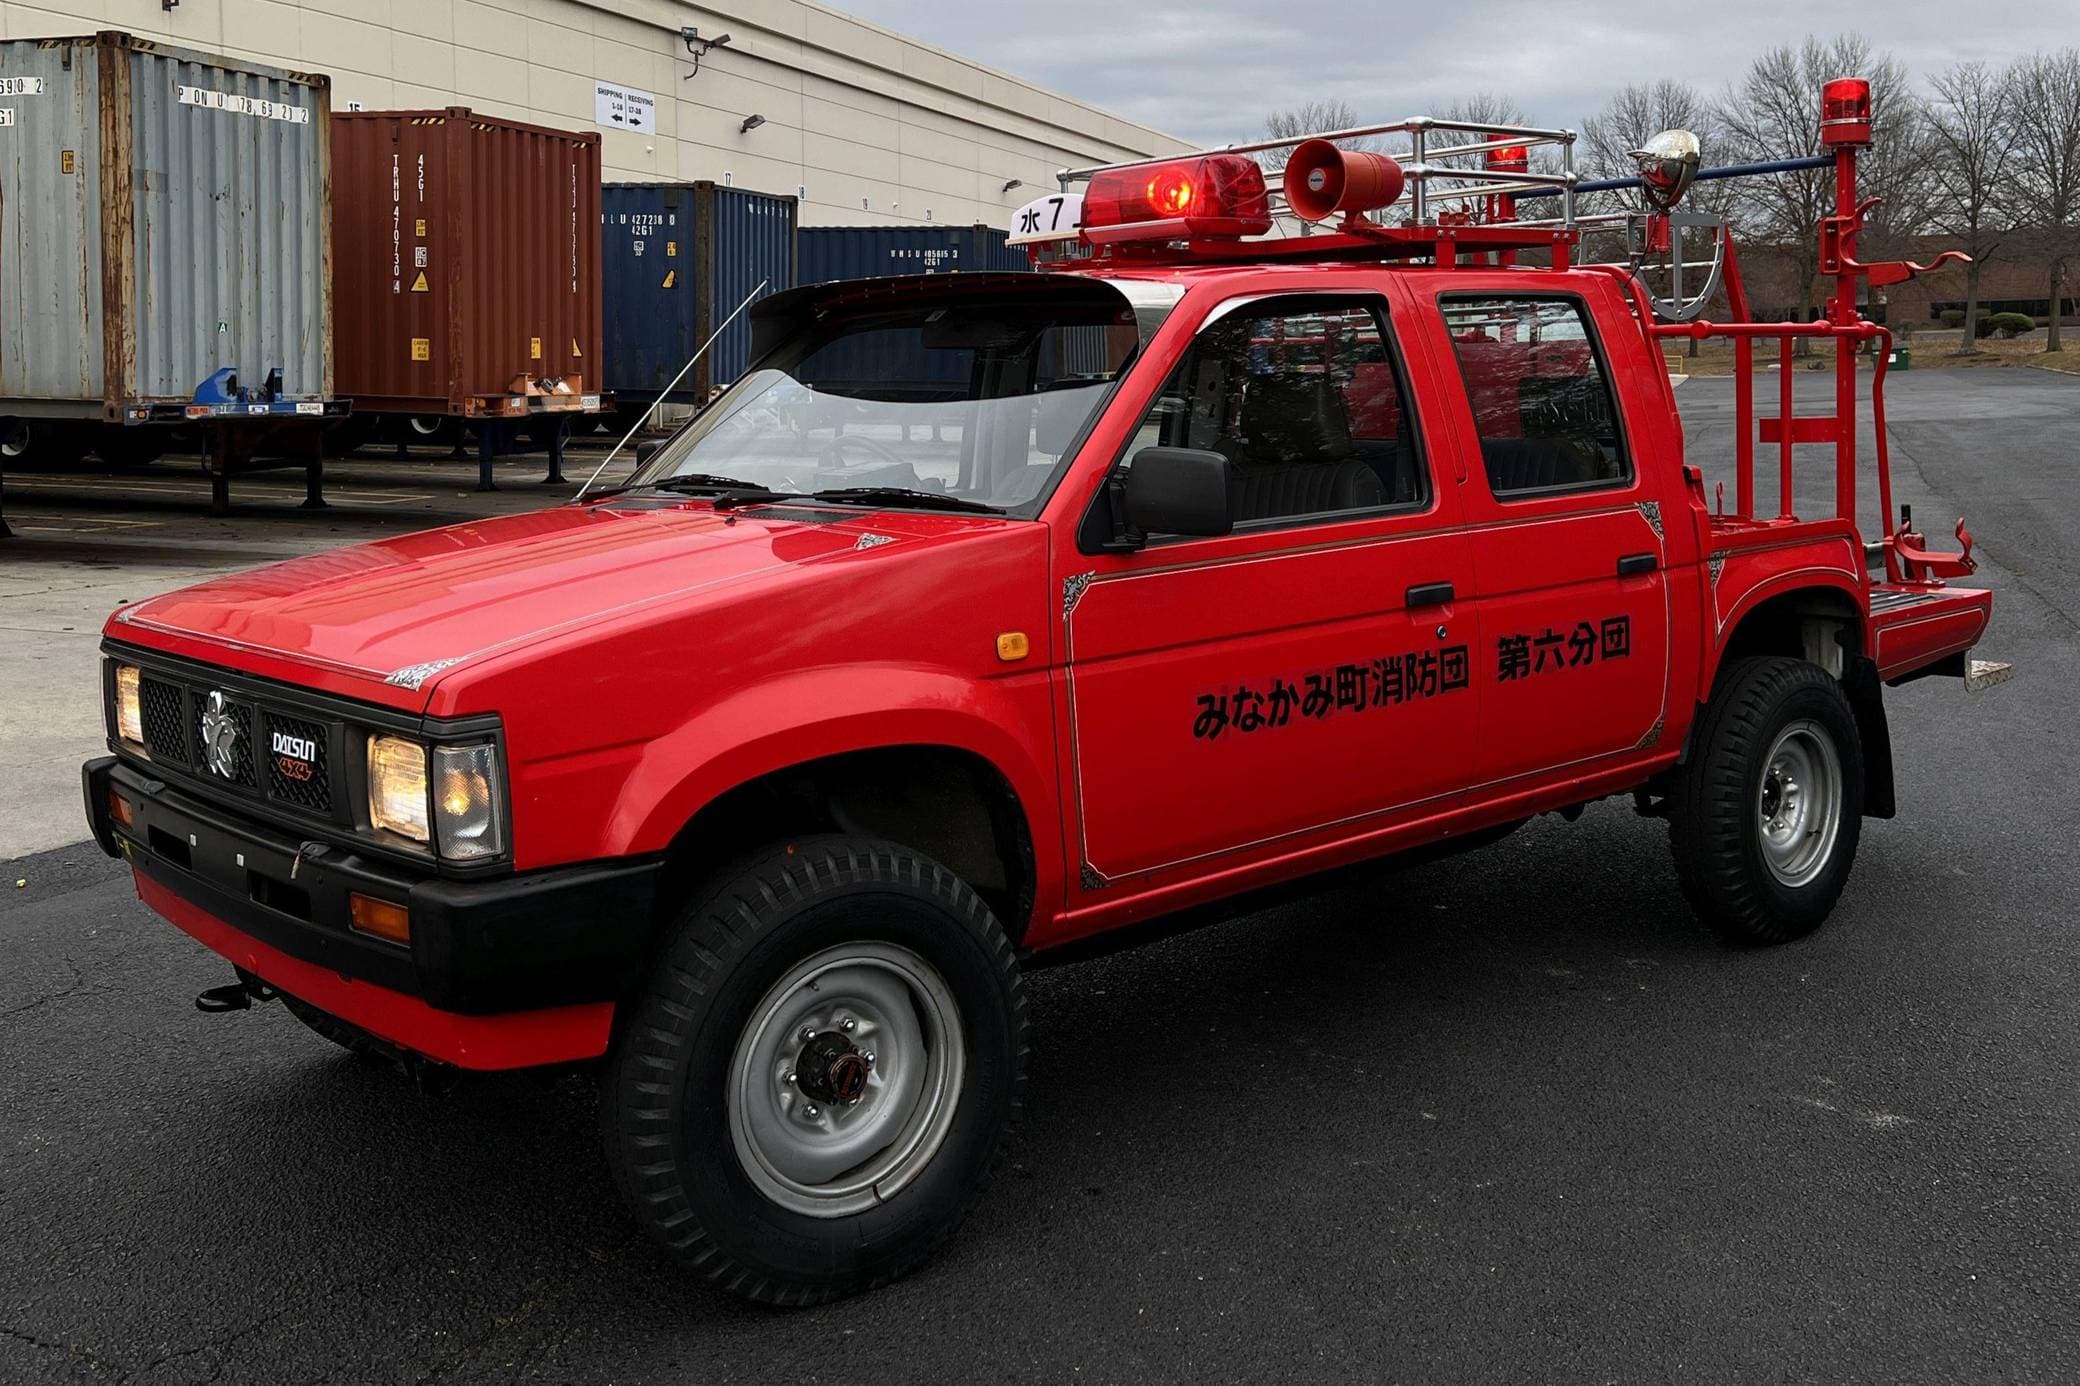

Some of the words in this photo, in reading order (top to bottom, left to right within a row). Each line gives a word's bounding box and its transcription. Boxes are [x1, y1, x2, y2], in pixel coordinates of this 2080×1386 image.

[36, 78, 42, 94] 2
[597, 87, 623, 99] SHIPPING
[179, 86, 223, 108] PONU
[628, 94, 653, 106] RECEIVING
[1192, 645, 1470, 741] みなかみ町消防団
[1498, 614, 1630, 682] 第六分団
[273, 732, 315, 762] DATSUN
